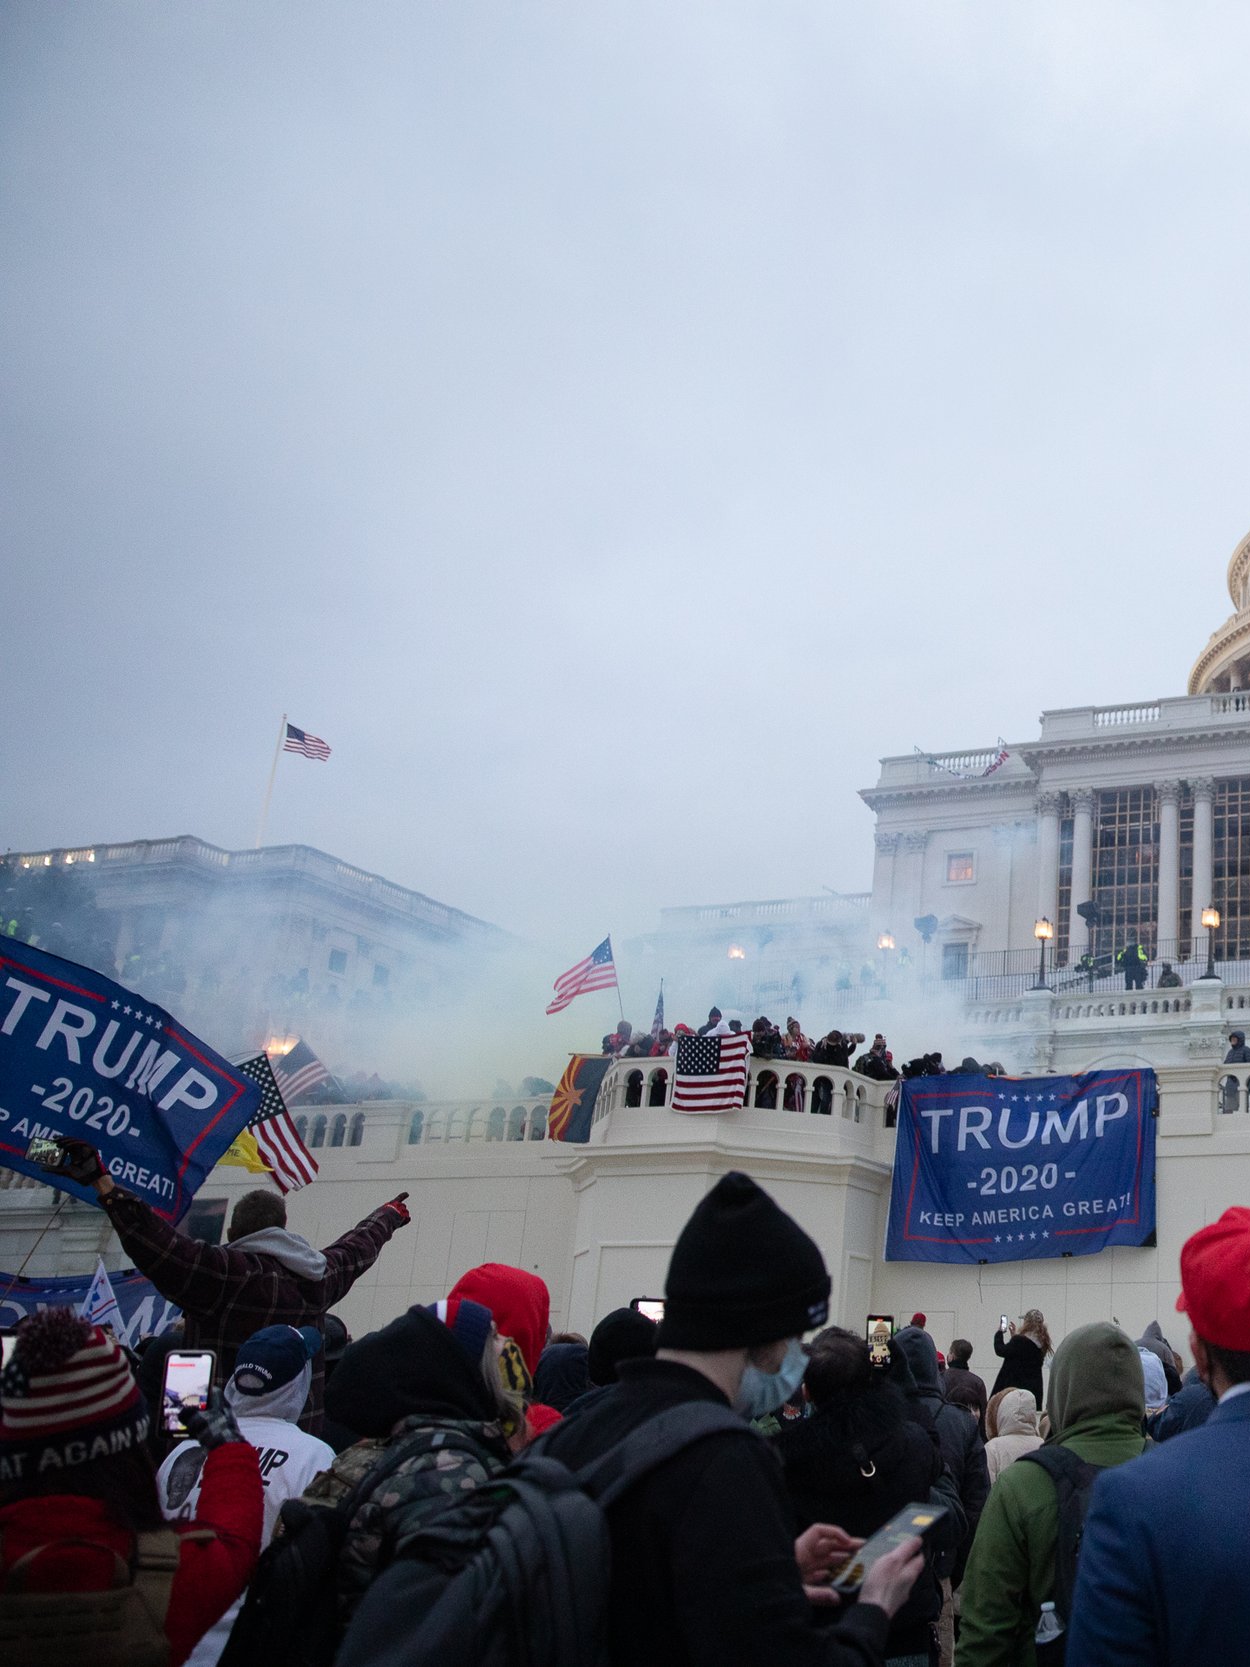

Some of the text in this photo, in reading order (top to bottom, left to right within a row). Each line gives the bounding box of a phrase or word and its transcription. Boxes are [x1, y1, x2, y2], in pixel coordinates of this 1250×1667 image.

[1, 976, 218, 1111] TRUMP
[31, 1077, 140, 1137] -2020-
[921, 1092, 1129, 1154] TRUMP
[108, 1156, 175, 1200] GREAT!
[967, 1163, 1076, 1196] -2020-
[919, 1192, 1131, 1227] KEEP AMERICA GREAT!
[38, 1427, 132, 1472] AGAIN
